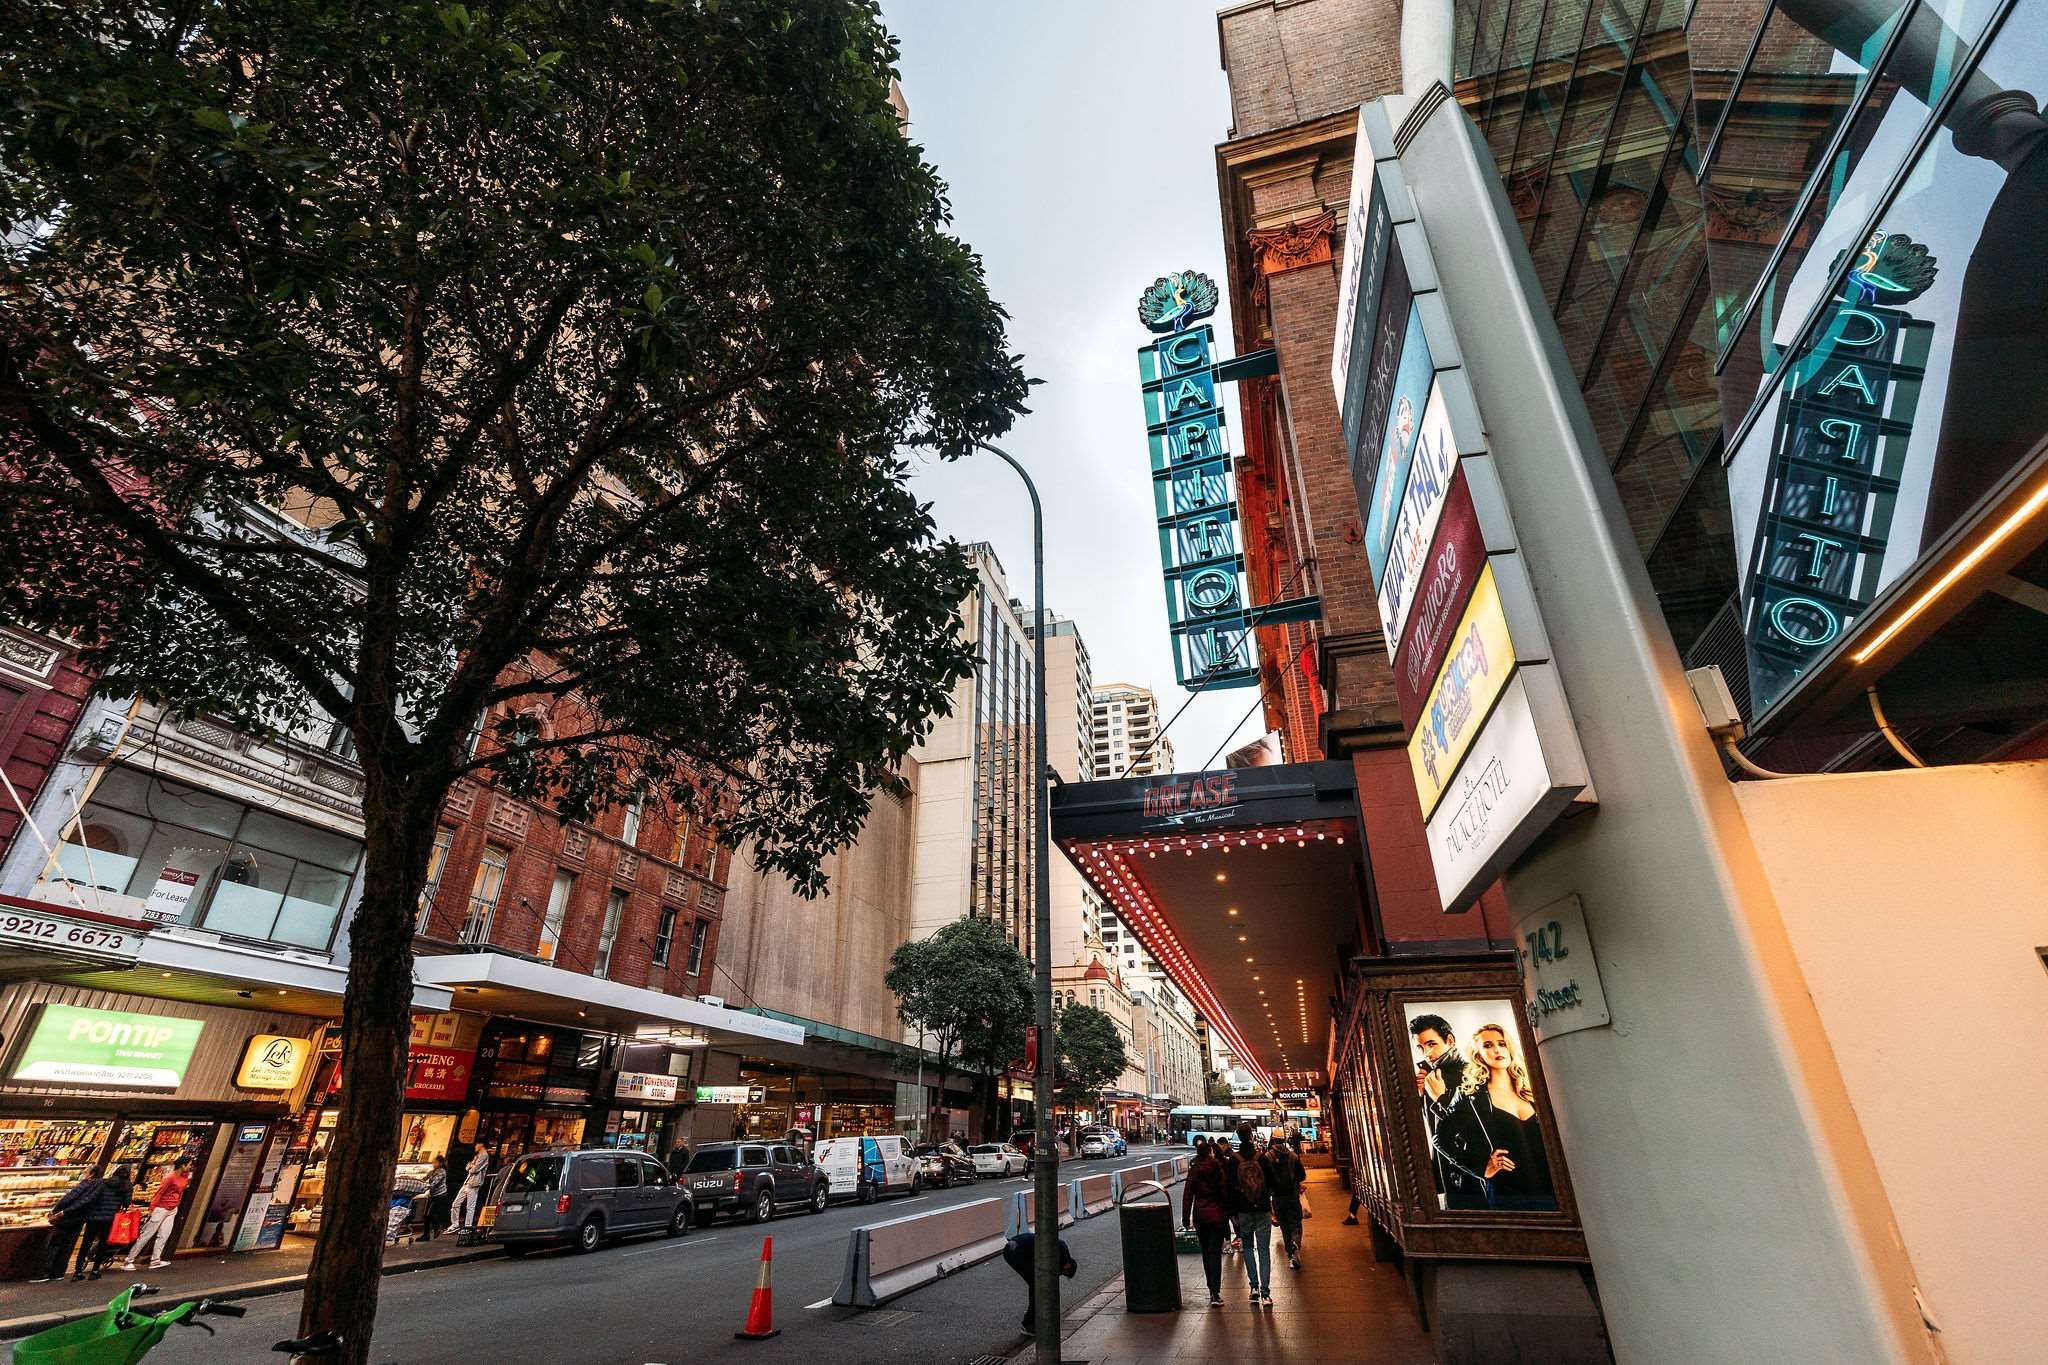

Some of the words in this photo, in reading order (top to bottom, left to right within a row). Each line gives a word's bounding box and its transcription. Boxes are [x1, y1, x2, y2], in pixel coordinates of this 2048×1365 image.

[1366, 203, 1384, 313] COFFEE
[1167, 333, 1239, 671] CAPITOL
[1385, 526, 1407, 632] MUAY
[1409, 432, 1441, 527] THAI
[1407, 527, 1423, 575] CAFE
[1143, 772, 1239, 818] GREASE
[1194, 815, 1206, 824] The
[1208, 809, 1236, 822] Musical
[1446, 800, 1478, 862] PALACE
[1475, 759, 1511, 822] HOTEL
[151, 889, 165, 898] For
[165, 892, 188, 904] Lease
[160, 913, 179, 923] 9800
[67, 928, 123, 949] 6673
[1526, 921, 1568, 969] 742
[1537, 978, 1582, 1017] Street
[481, 1048, 495, 1058] 20
[644, 1076, 676, 1088] CONVENIENCE
[650, 1088, 667, 1098] STORE
[693, 1179, 724, 1190] ISUZU
